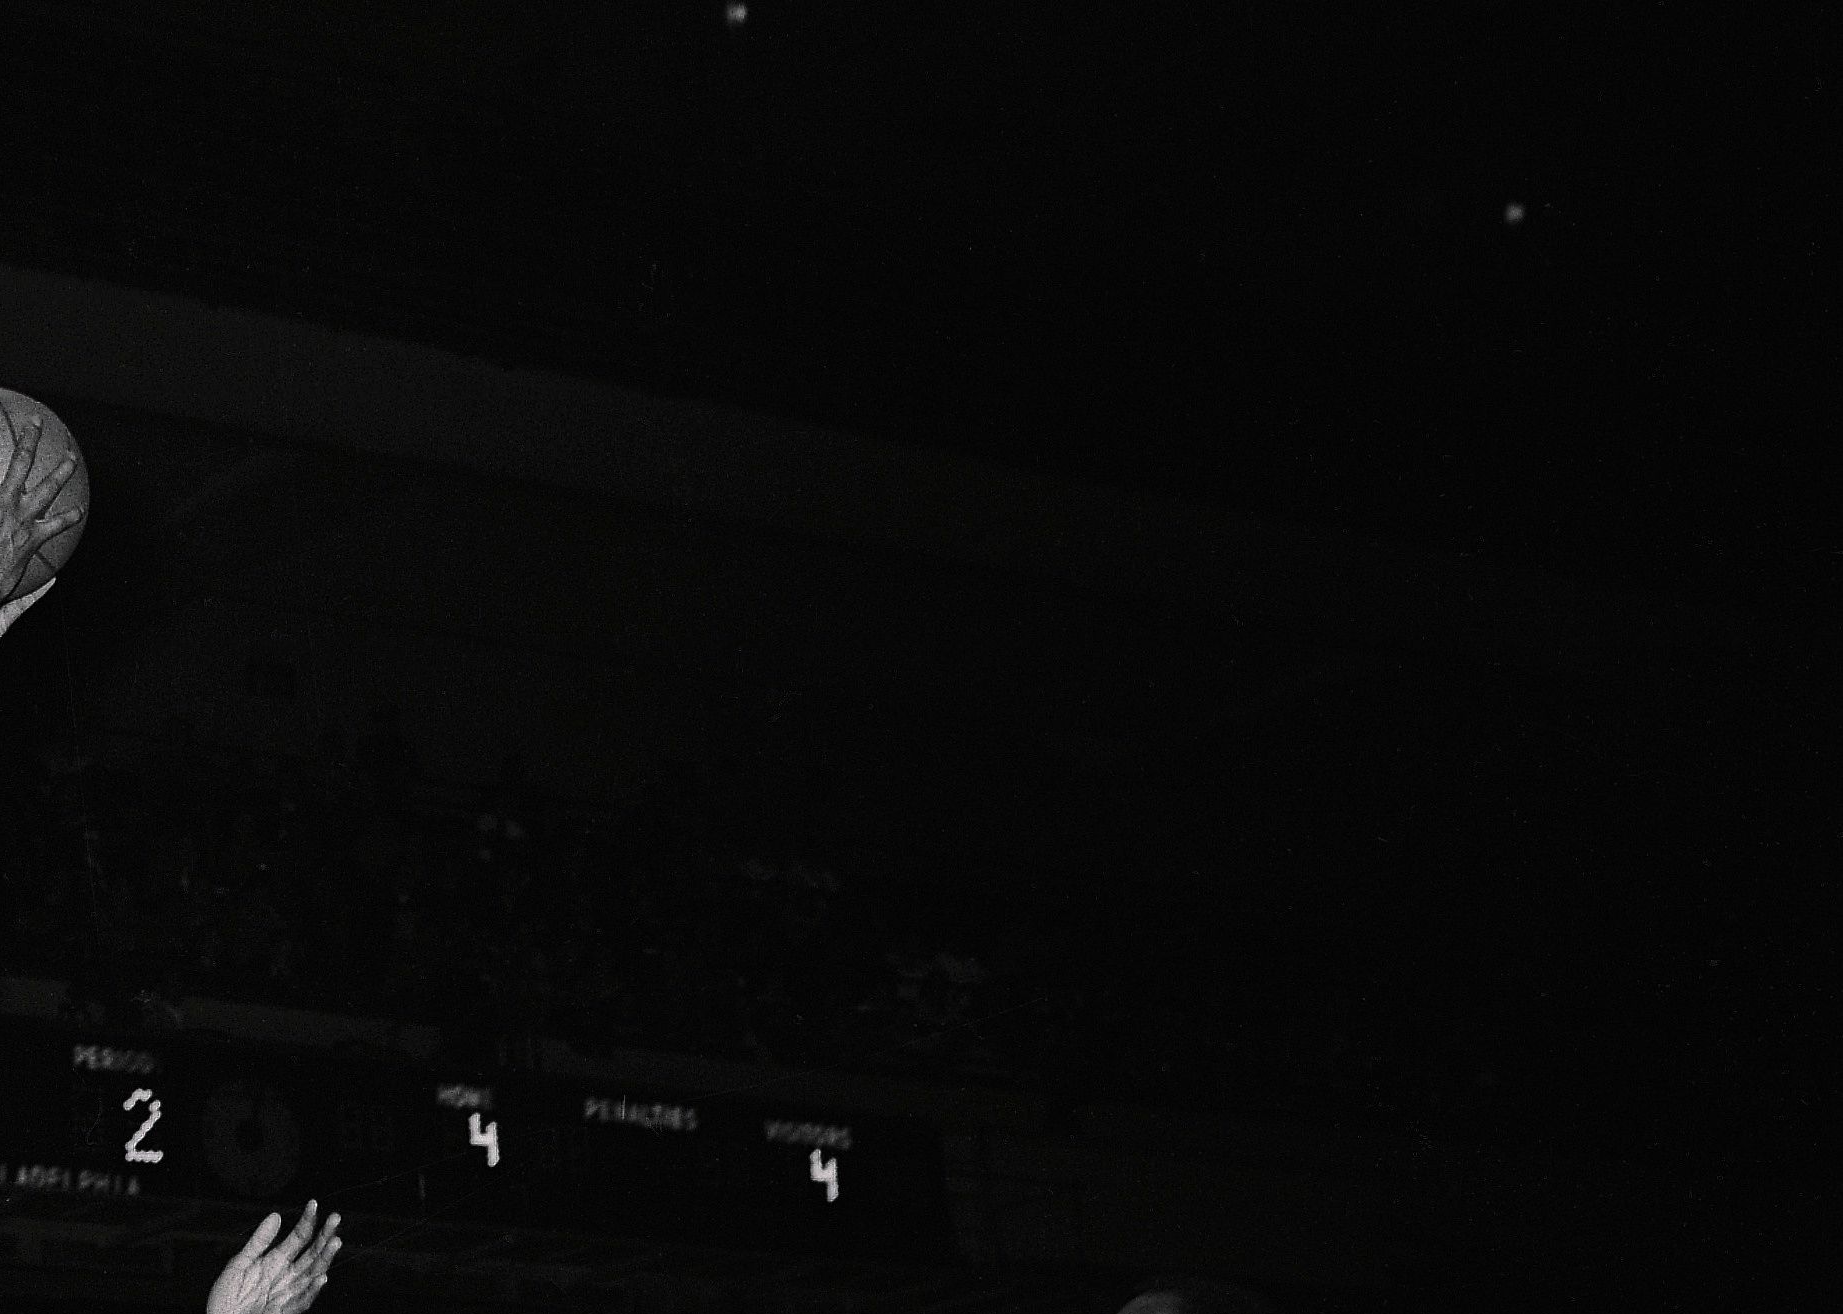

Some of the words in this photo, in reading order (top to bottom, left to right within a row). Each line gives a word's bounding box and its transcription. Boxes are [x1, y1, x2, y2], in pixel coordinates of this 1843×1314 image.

[122, 1087, 165, 1165] 2
[467, 1111, 502, 1169] 4
[807, 1146, 841, 1204] 4
